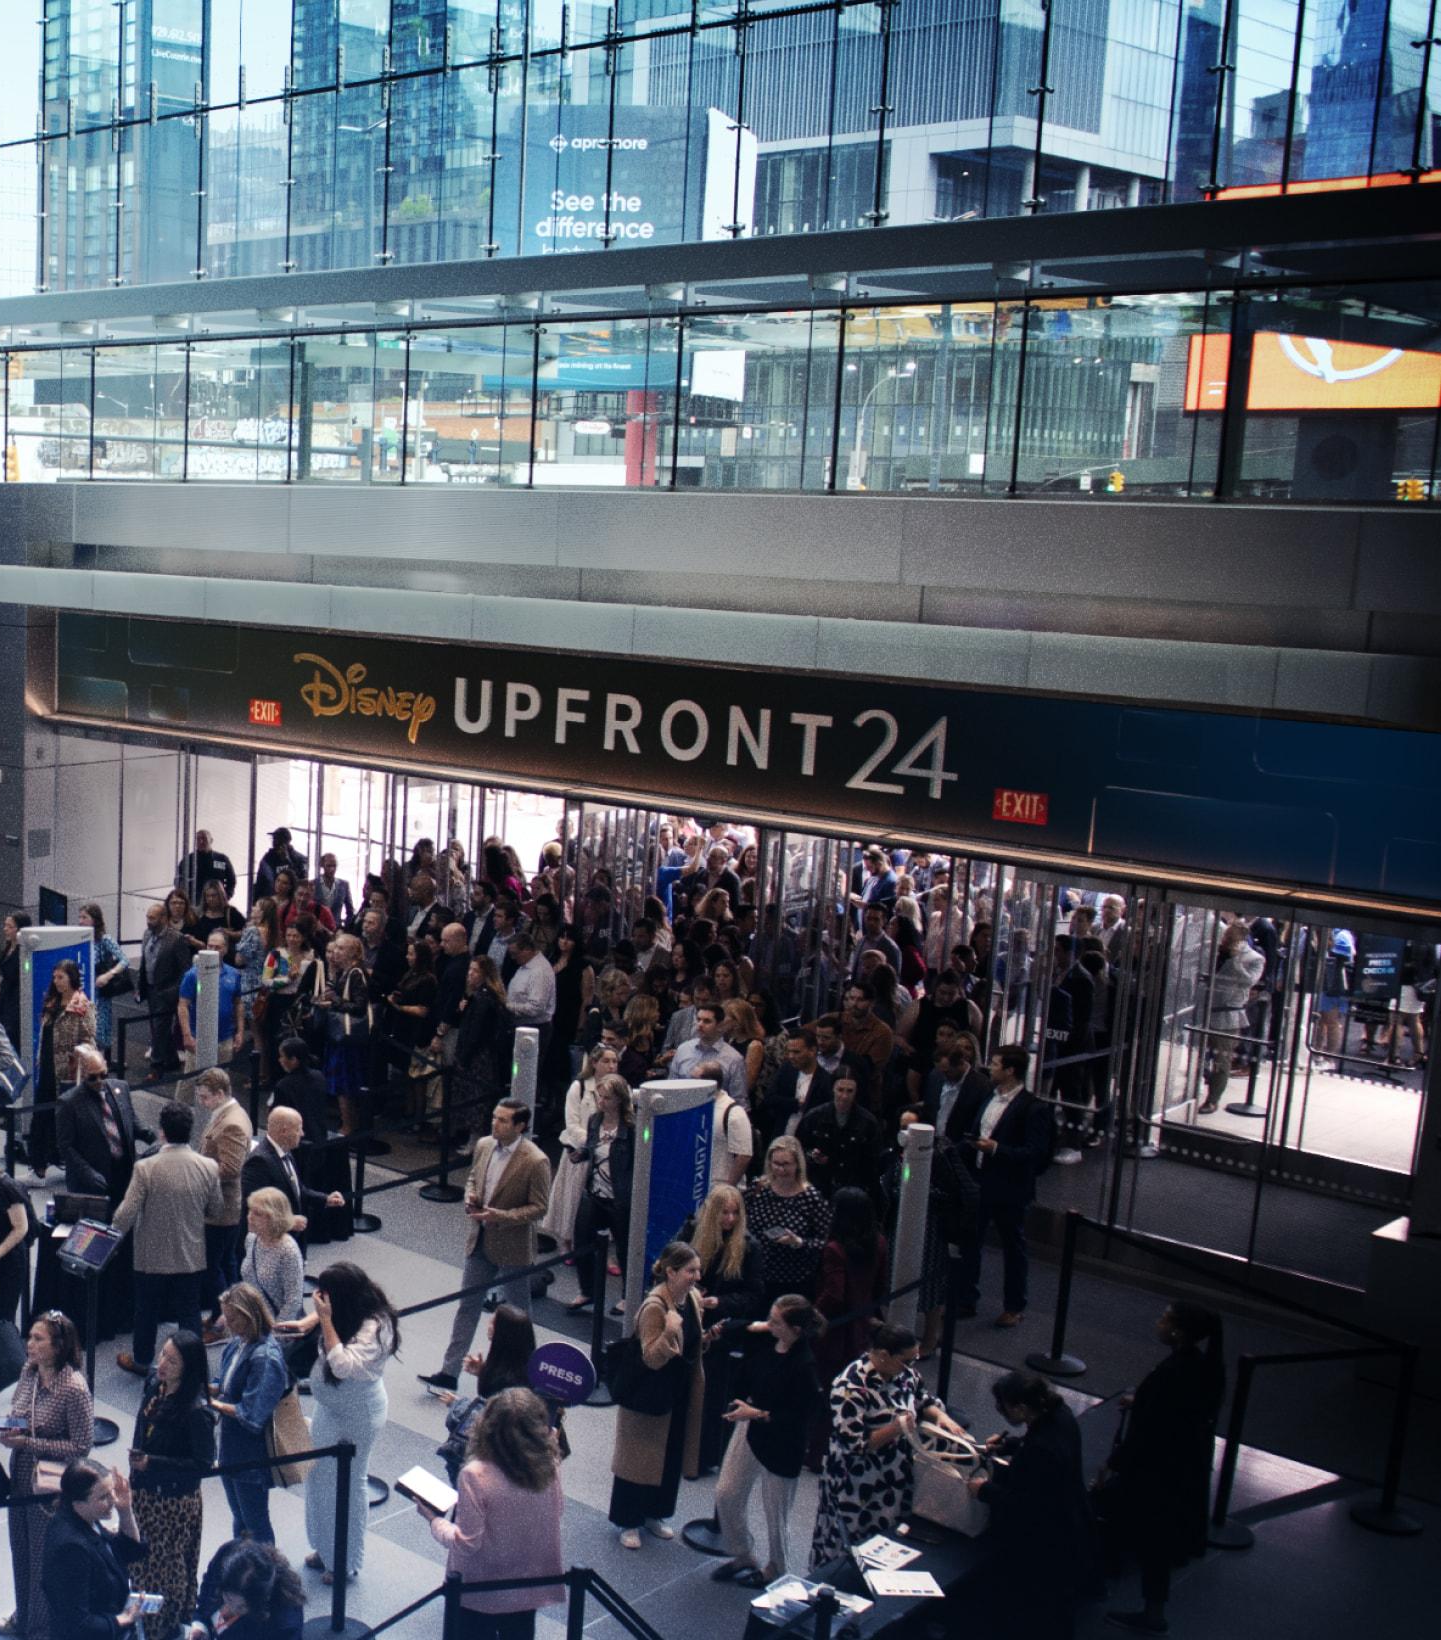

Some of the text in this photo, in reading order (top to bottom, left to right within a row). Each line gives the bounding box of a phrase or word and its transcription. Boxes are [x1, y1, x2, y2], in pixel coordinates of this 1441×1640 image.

[551, 190, 642, 212] See the
[535, 216, 654, 239] difference
[254, 700, 276, 722] EXIT
[292, 652, 959, 800] Disney UPFRONT 24
[1001, 791, 1040, 820] EXIT
[539, 1361, 583, 1386] PRESS
